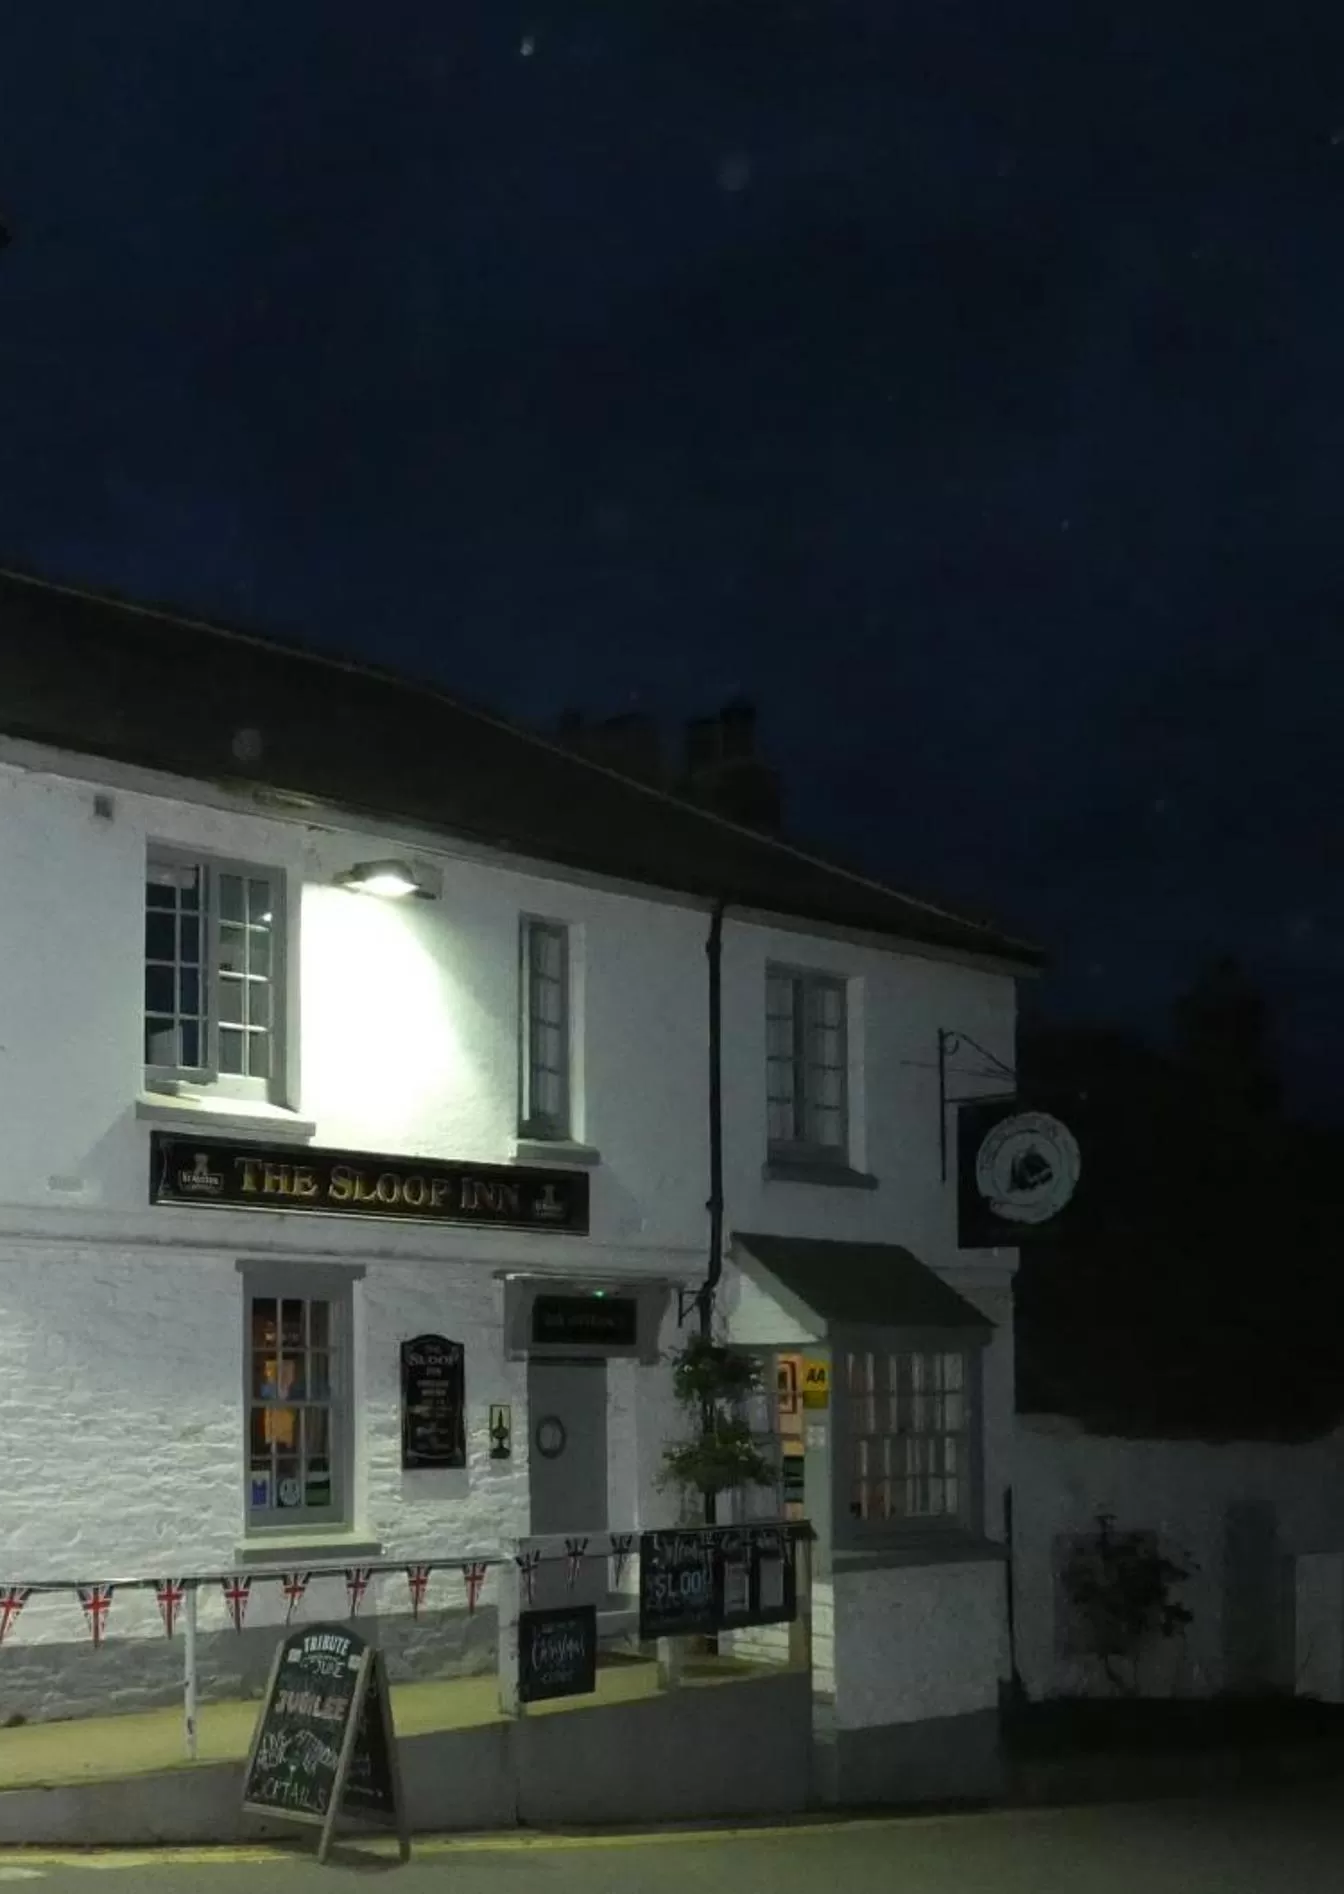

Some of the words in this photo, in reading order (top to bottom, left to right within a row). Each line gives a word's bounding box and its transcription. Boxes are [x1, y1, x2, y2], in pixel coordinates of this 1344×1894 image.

[234, 1156, 318, 1196] THE
[328, 1164, 452, 1207] SLOOP
[459, 1176, 521, 1213] INN
[806, 1368, 826, 1384] AA
[303, 1633, 352, 1656] TRIBUTE
